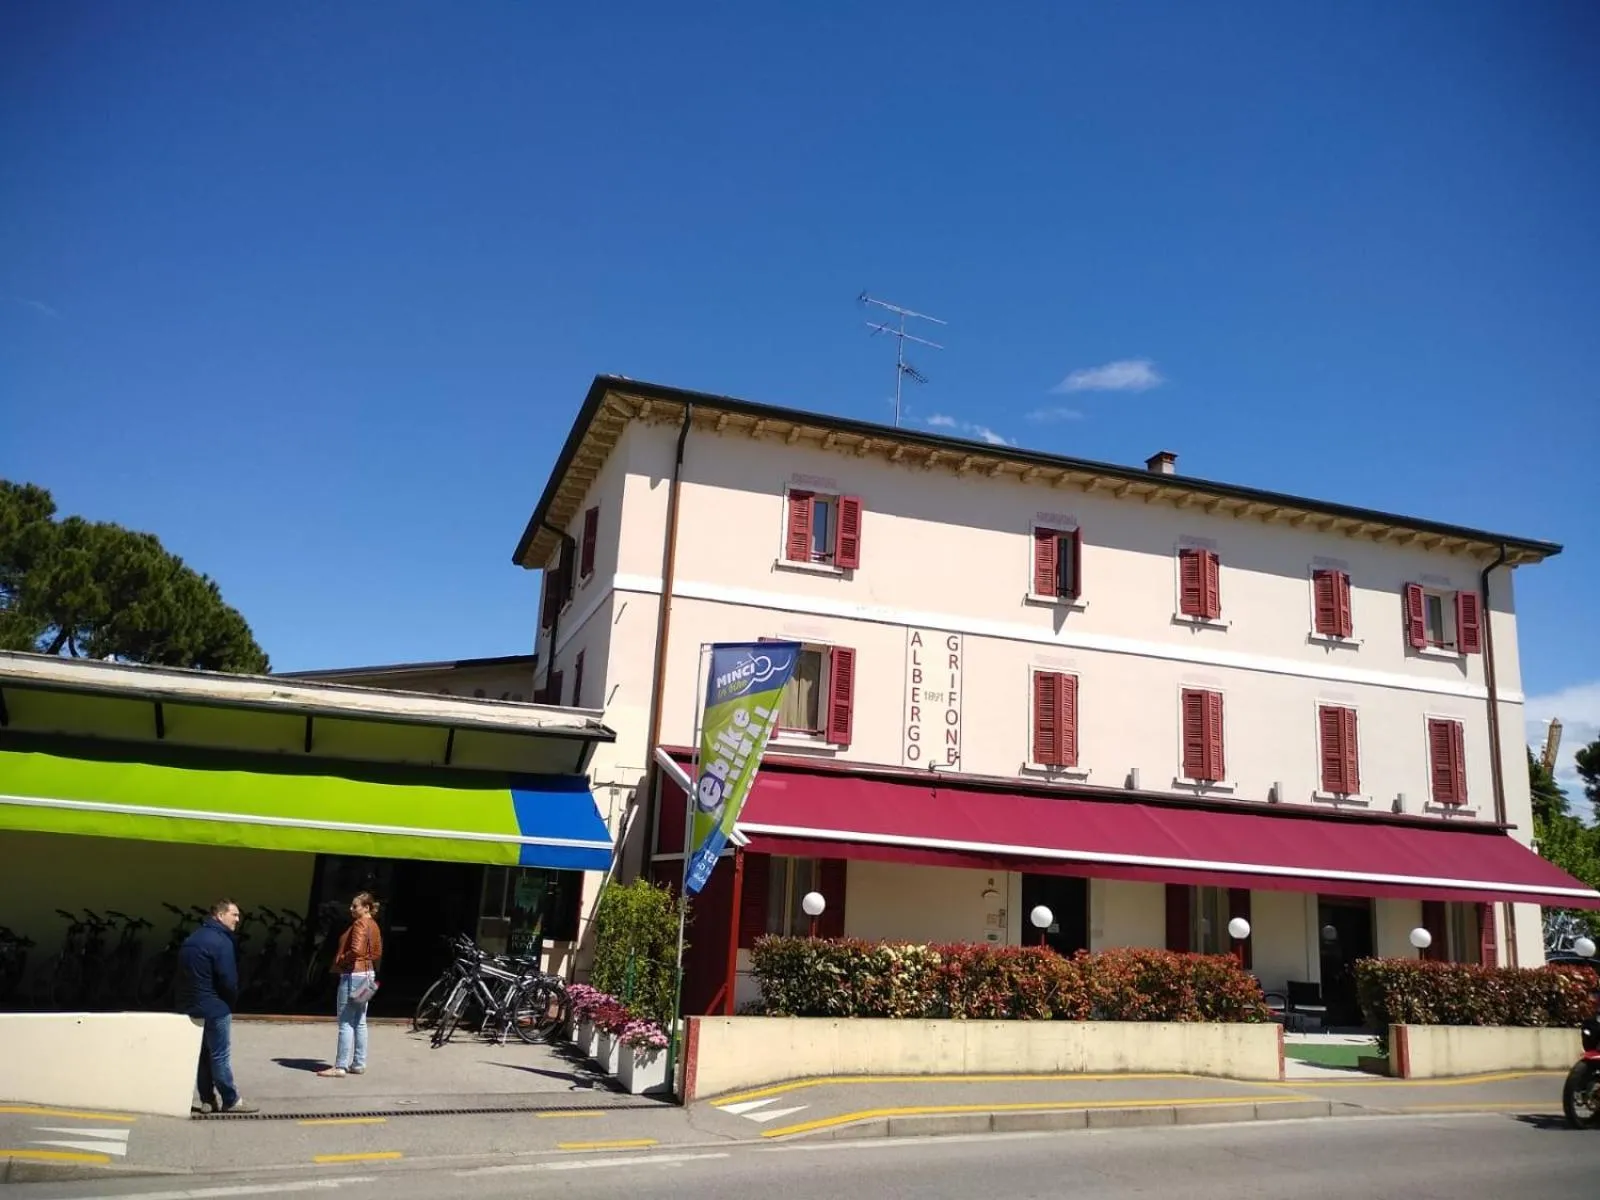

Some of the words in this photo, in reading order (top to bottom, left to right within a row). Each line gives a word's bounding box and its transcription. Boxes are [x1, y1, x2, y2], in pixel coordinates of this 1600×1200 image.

[698, 708, 750, 809] ebike
[907, 631, 923, 761] ALBERGO
[945, 635, 959, 764] GRIFONE
